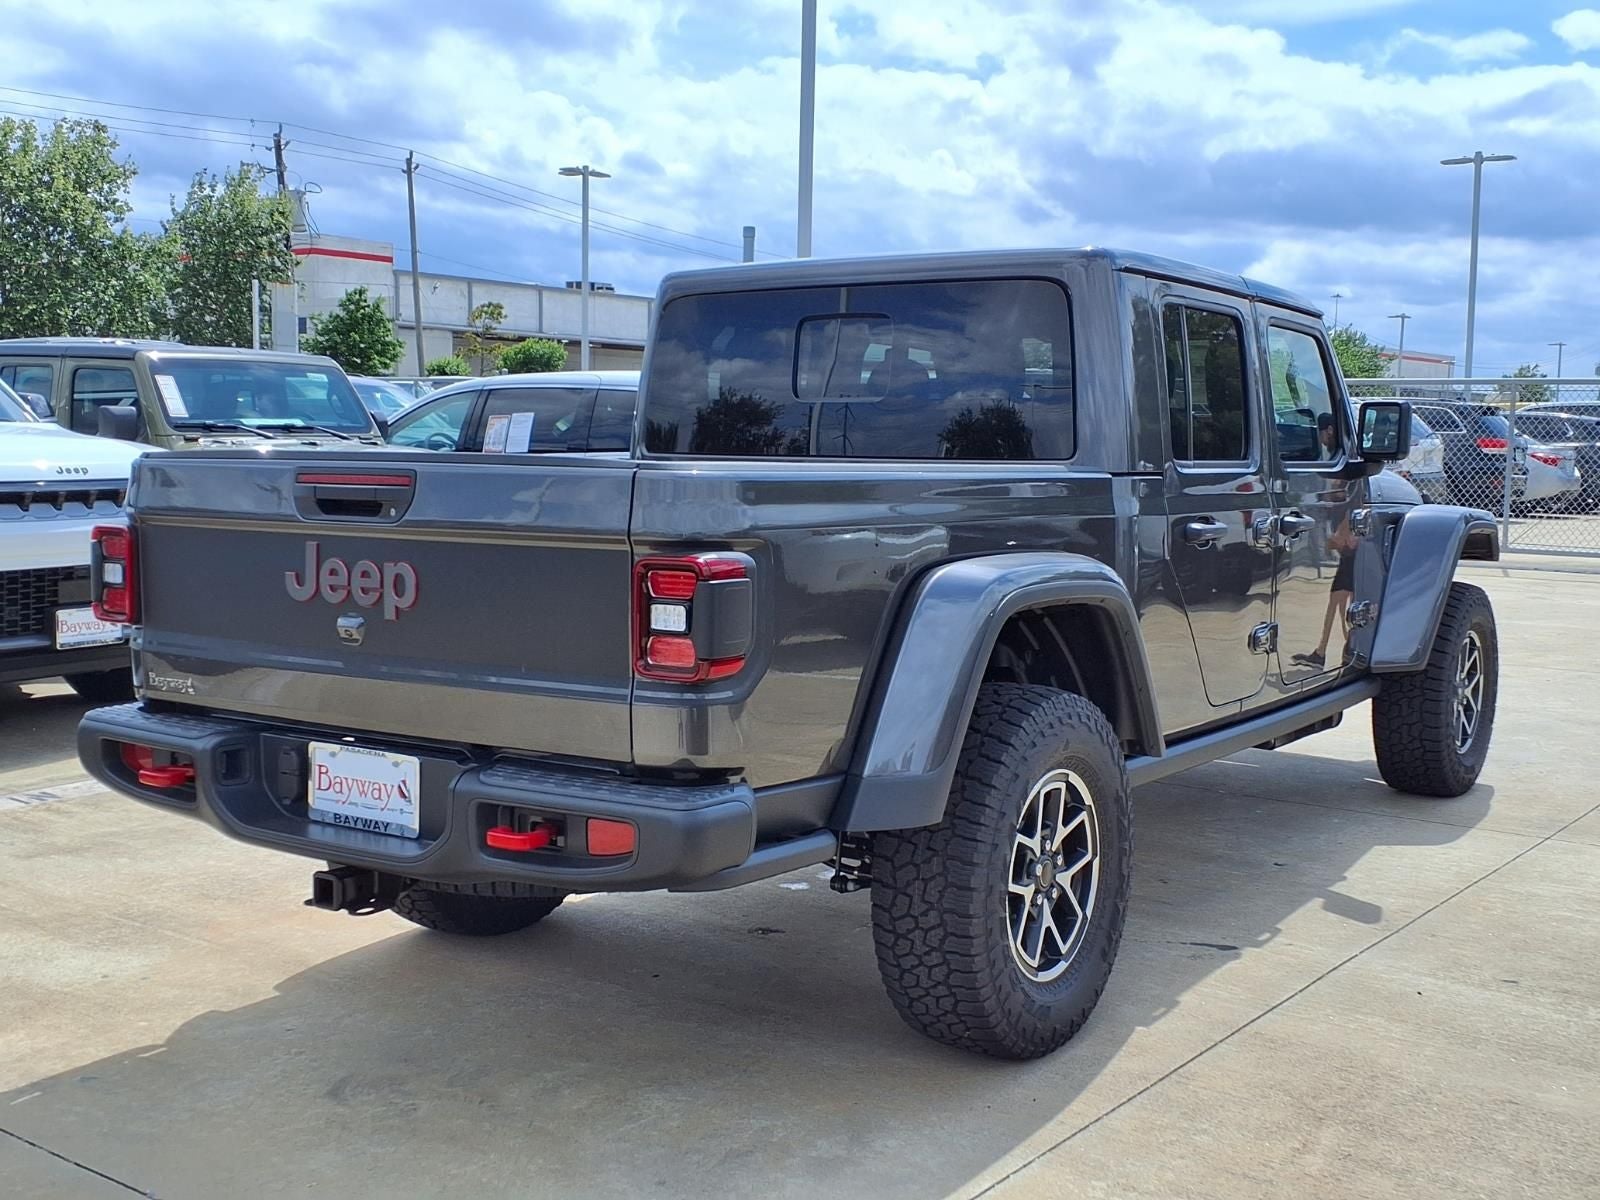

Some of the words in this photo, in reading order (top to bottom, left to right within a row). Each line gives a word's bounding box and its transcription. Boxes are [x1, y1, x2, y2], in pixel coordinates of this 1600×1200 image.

[56, 466, 88, 475] Jeep
[285, 541, 418, 620] Jeep
[60, 620, 105, 635] Bayway
[316, 764, 394, 811] Bayway
[334, 813, 389, 832] BAYWAY
